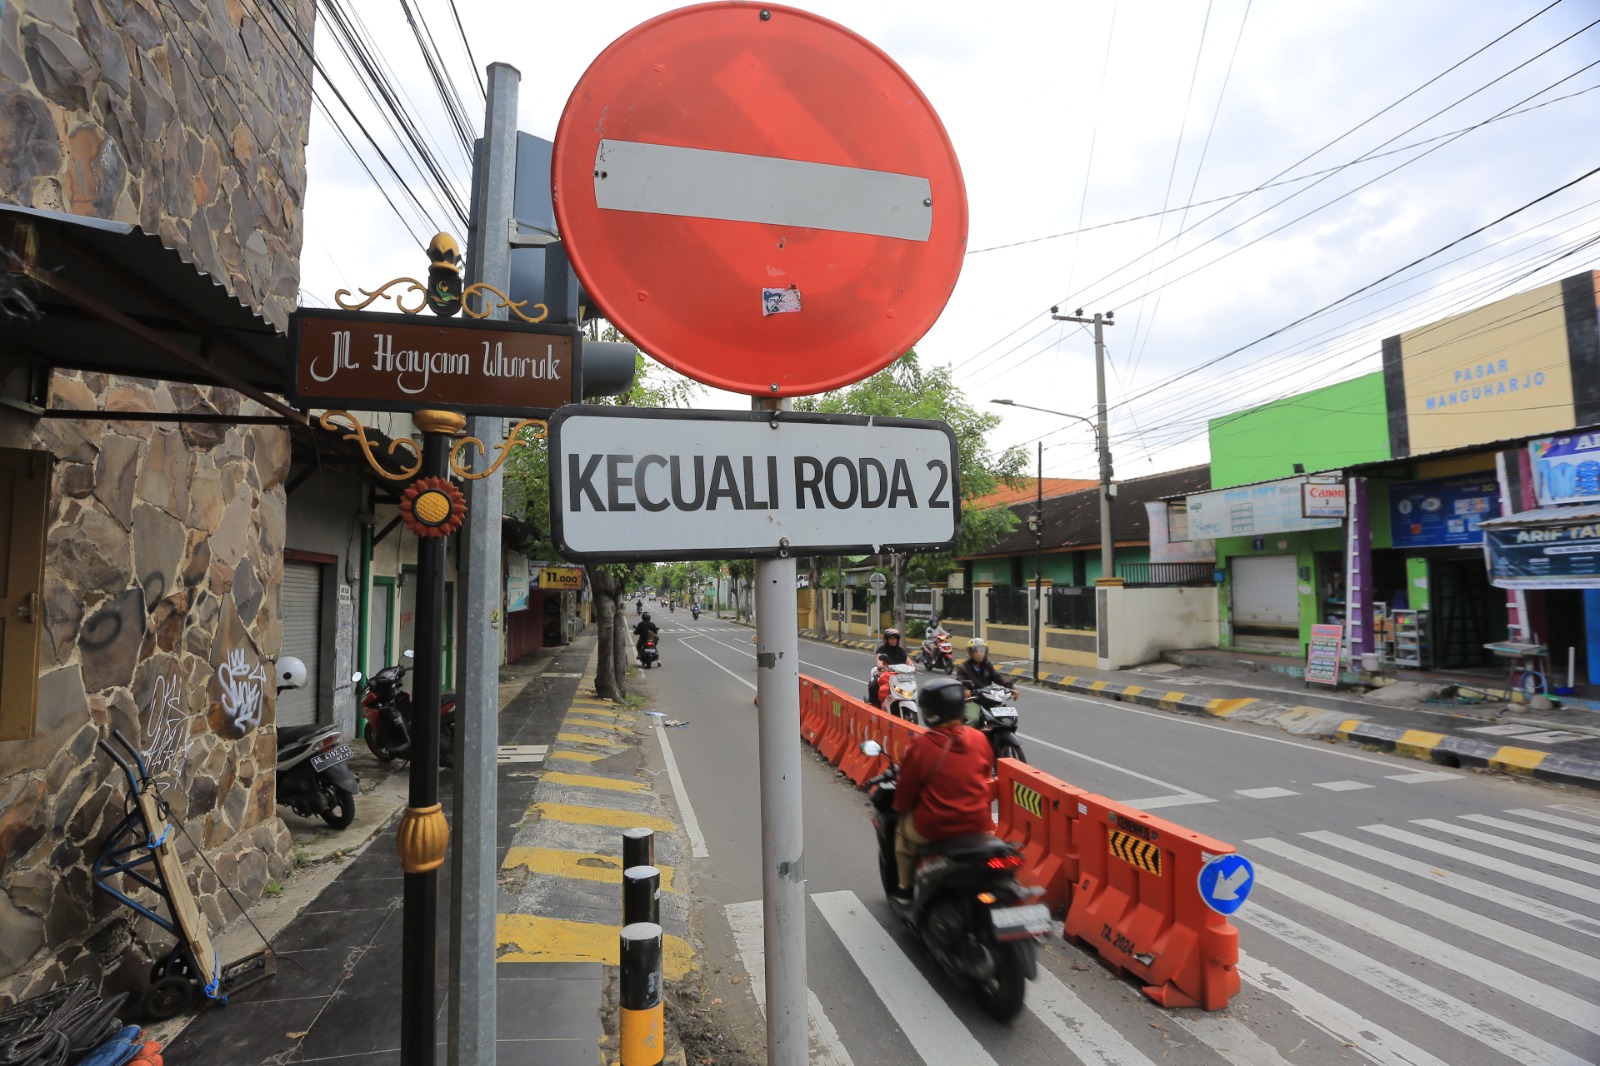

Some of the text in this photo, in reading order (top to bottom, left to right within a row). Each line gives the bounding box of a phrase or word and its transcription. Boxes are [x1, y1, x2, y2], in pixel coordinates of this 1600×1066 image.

[371, 333, 470, 394] Hayam
[482, 341, 561, 381] Wuruk
[1454, 359, 1508, 383] PASAR
[1426, 371, 1545, 409] MANGUHARJO
[568, 453, 950, 512] KECUALI RODA 2
[1309, 487, 1345, 498] Canon
[1516, 528, 1563, 544] ARIF
[1113, 933, 1135, 956] 2024
